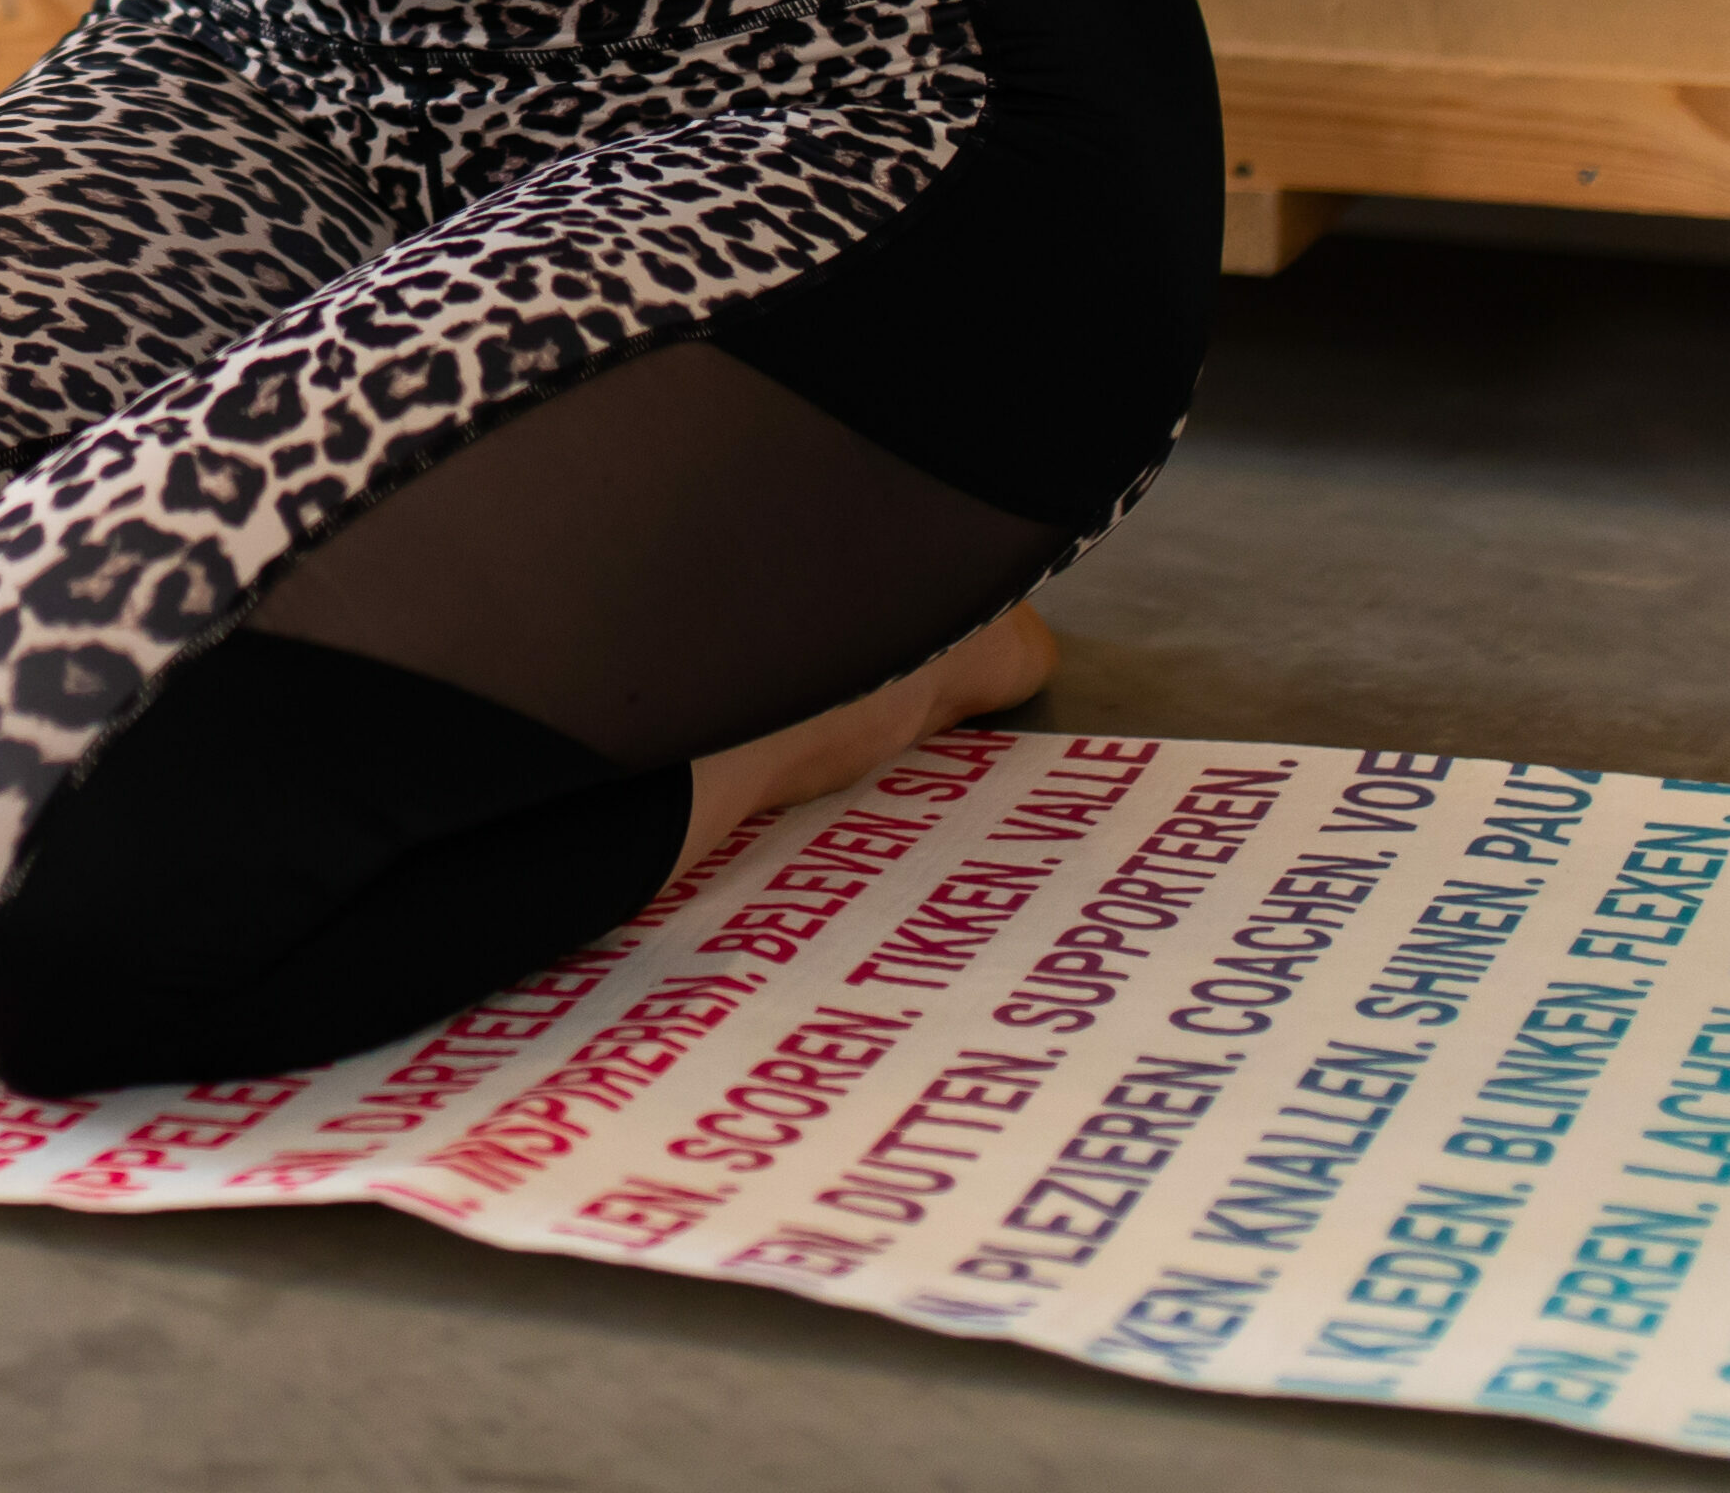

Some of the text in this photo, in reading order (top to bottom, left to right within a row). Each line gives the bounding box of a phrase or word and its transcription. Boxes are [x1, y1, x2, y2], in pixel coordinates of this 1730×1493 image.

[666, 1006, 924, 1173] SCOREN.
[845, 857, 1062, 990] TIKKEN.
[696, 810, 943, 965] BELEVEN.
[816, 1049, 1069, 1224] DUTTEN.
[992, 760, 1298, 1033] SUPPORTEREN.
[952, 1053, 1246, 1289] PLEZIEREN.
[1170, 850, 1398, 1037] COACHEN.
[1193, 1041, 1436, 1252] KNALLEN.
[1355, 876, 1546, 1029] SHINEN.
[1305, 1182, 1534, 1365] KLEDEN.
[1442, 978, 1655, 1167] BLINKEN.
[1540, 1200, 1721, 1338] EREN.
